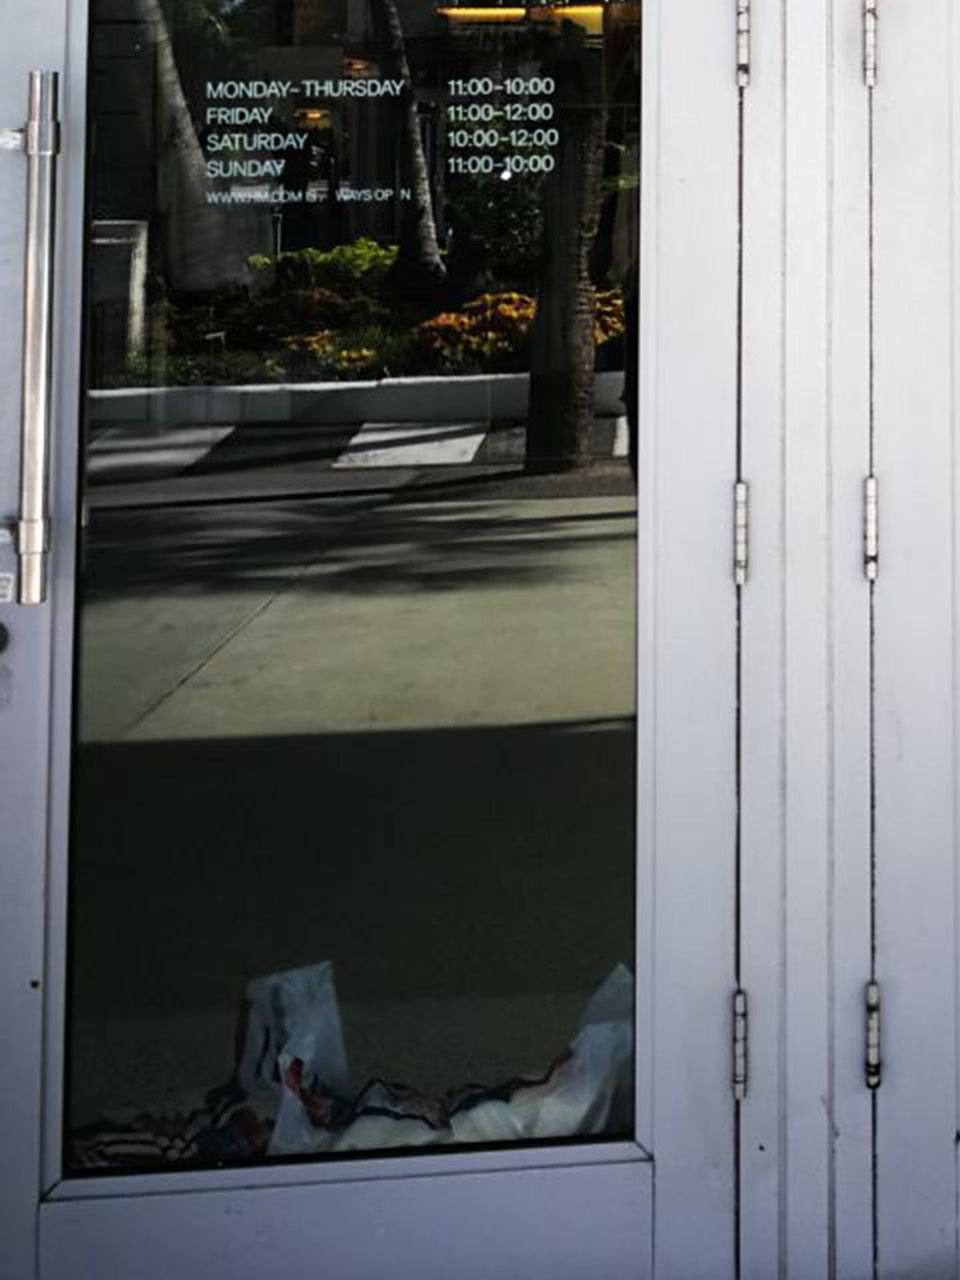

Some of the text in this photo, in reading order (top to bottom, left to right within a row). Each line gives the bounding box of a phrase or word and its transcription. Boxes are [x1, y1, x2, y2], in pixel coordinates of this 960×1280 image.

[206, 107, 273, 124] FRIDAY
[206, 133, 308, 151] SATURDAY
[206, 160, 286, 178] SUNDAY
[374, 188, 412, 201] OPN
